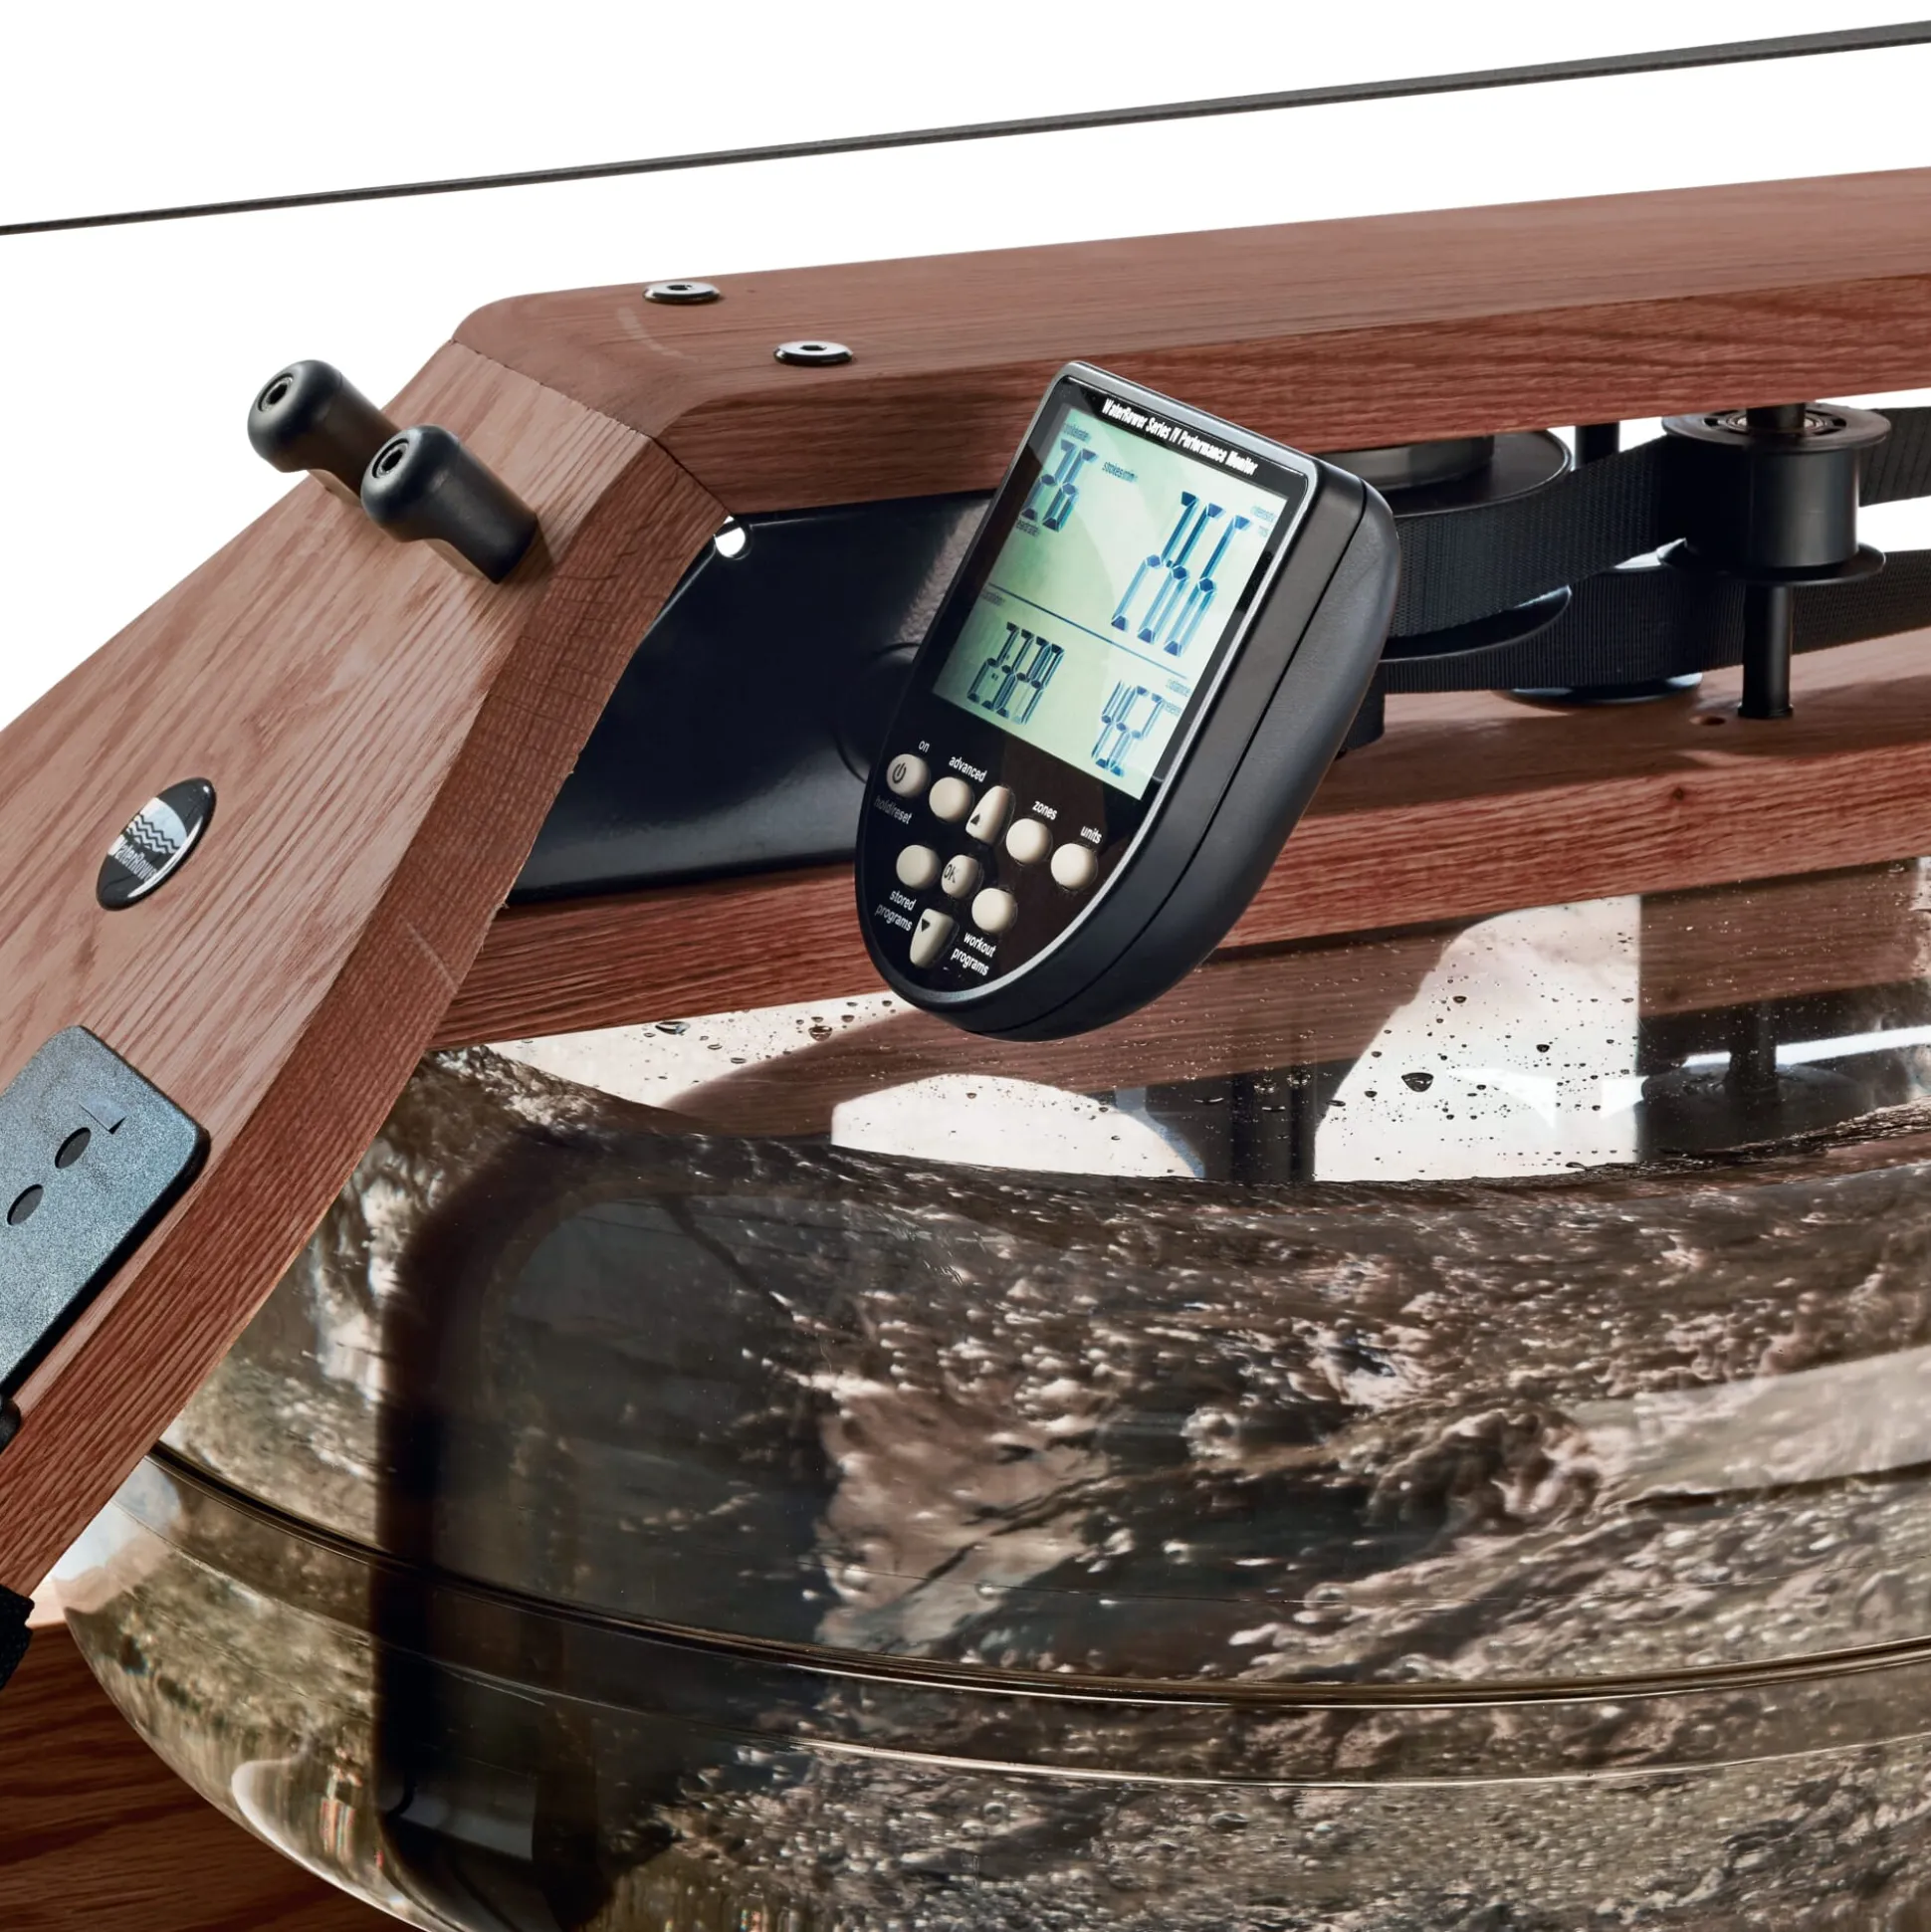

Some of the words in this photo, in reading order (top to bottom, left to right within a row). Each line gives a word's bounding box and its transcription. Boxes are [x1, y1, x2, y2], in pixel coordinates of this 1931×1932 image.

[1102, 398, 1149, 428] WaterRower
[1146, 417, 1172, 440] Series
[1179, 431, 1228, 463] Performance
[1226, 451, 1258, 475] Monitor
[1021, 439, 1098, 533] 26
[918, 741, 930, 752] on
[949, 755, 987, 782] advanced
[874, 795, 913, 825] hold/reset
[1032, 800, 1057, 820] zones
[1080, 824, 1102, 844] units
[943, 863, 958, 884] OK
[889, 890, 917, 911] stored
[875, 904, 913, 932] programs
[964, 932, 996, 958] workout
[950, 947, 989, 976] programs
